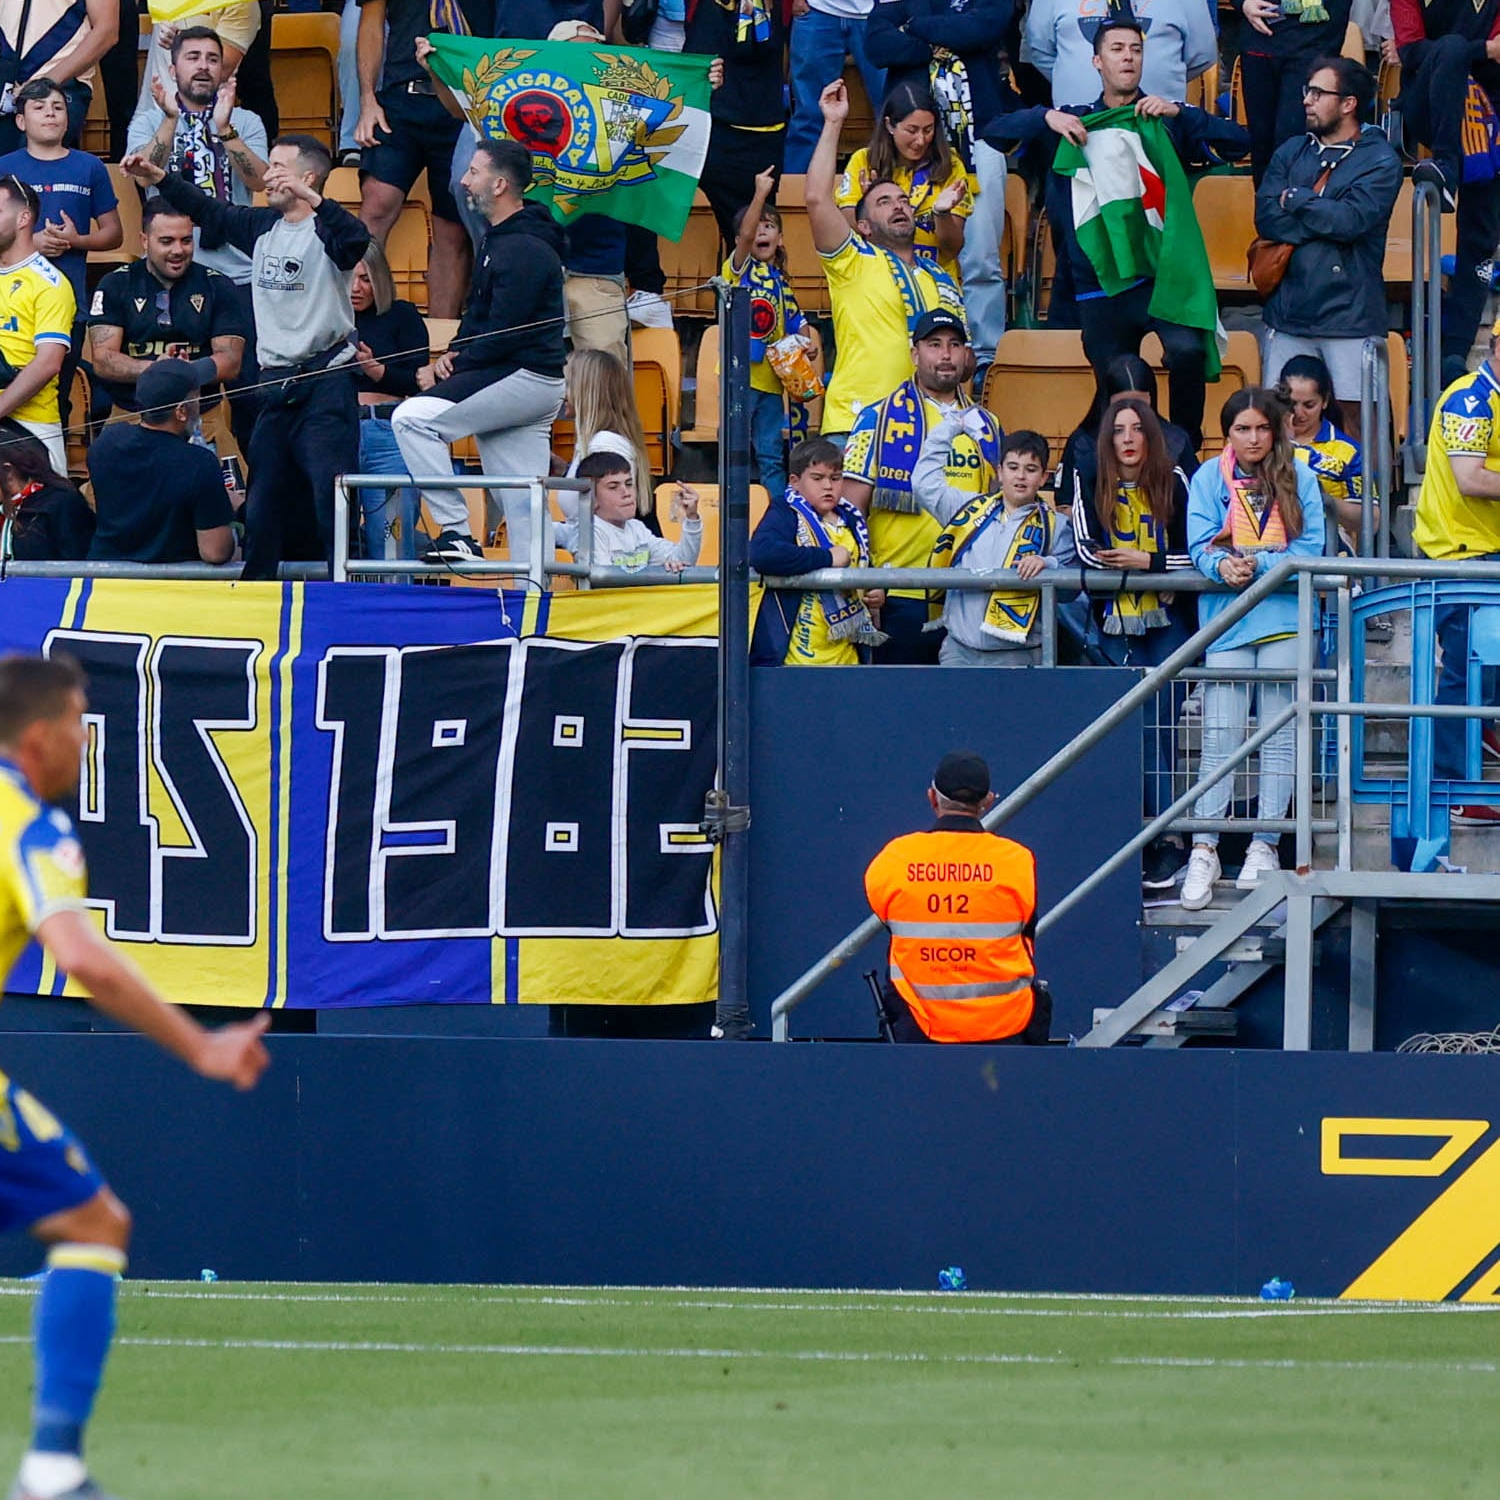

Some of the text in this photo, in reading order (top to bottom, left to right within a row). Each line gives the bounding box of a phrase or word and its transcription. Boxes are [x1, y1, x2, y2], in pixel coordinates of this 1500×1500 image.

[906, 861, 994, 883] SEGURIDAD
[926, 892, 970, 915] 012
[919, 947, 977, 963] SICOR
